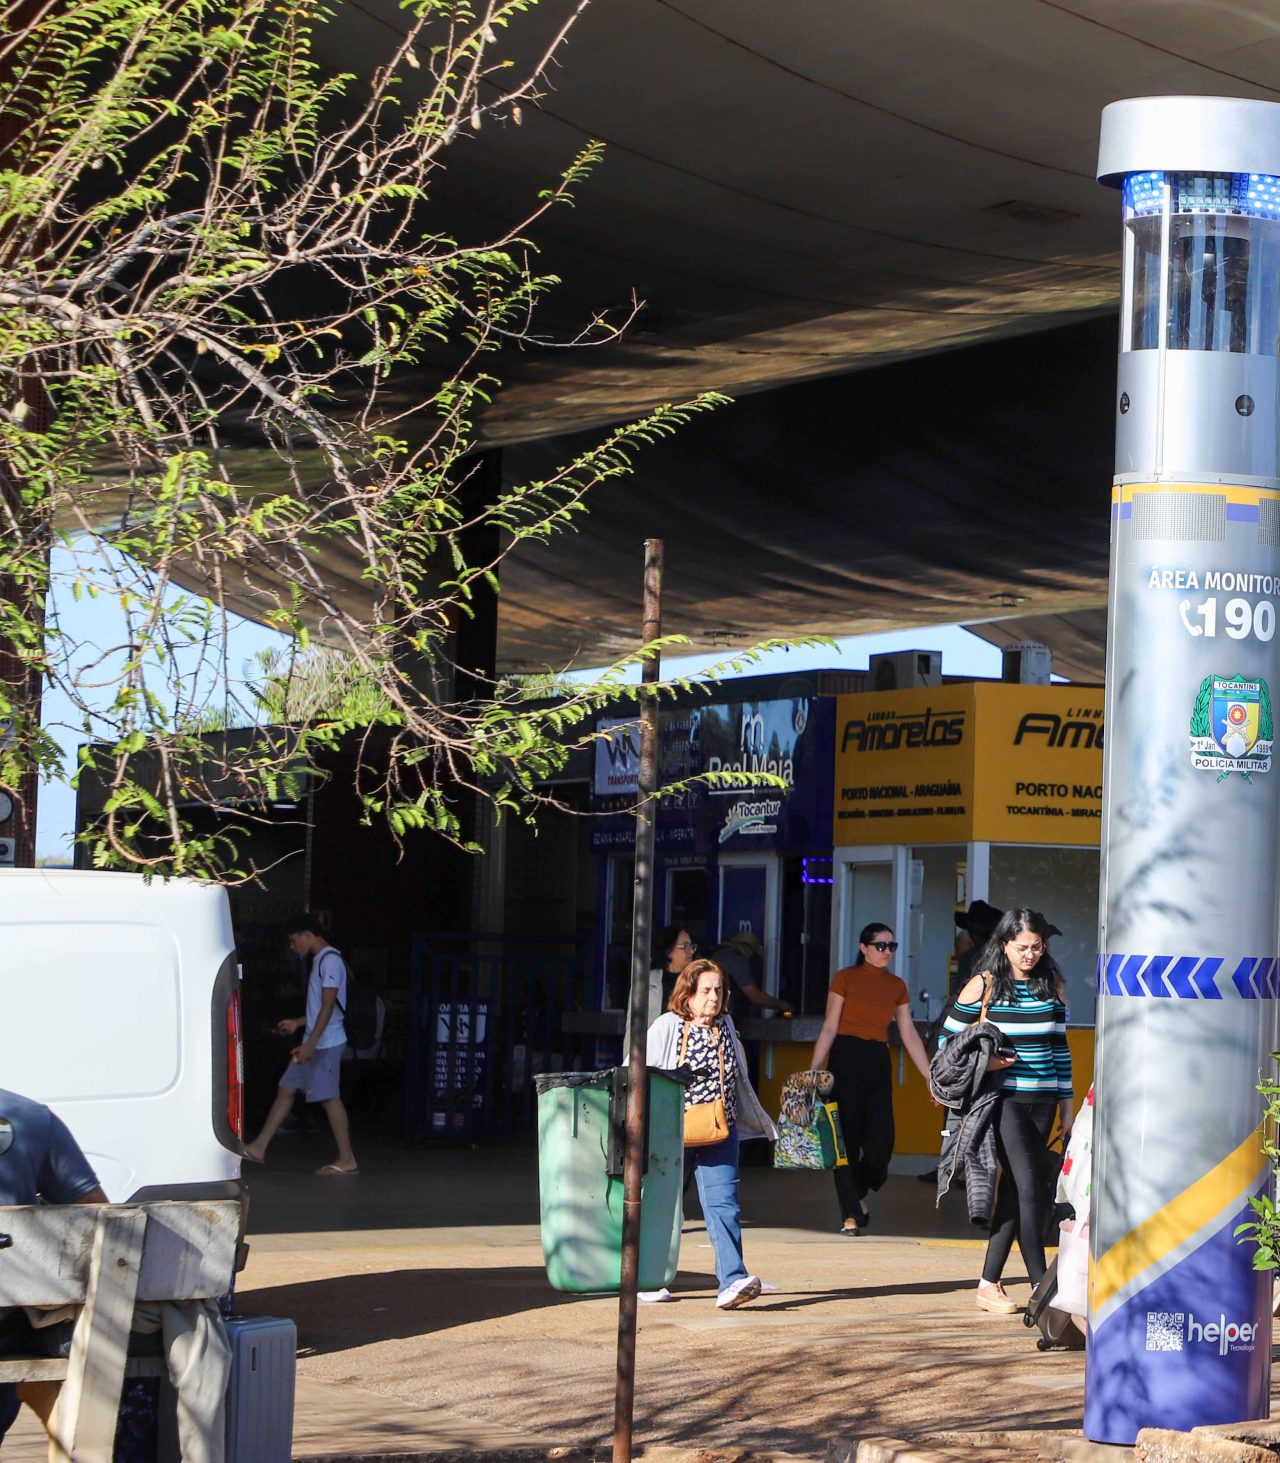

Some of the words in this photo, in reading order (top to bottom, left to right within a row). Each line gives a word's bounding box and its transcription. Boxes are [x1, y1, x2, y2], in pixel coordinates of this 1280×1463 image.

[1148, 566, 1199, 590] ÁREA
[1197, 598, 1276, 642] 190
[1217, 682, 1257, 691] TOCANTINS
[1195, 758, 1234, 768] POLÍCIA
[1236, 760, 1268, 770] MILITAR
[842, 787, 868, 800] PORTO
[1016, 782, 1068, 798] PORTO
[738, 798, 781, 816] Tocantur
[1006, 804, 1064, 816] TOCANTÍNIA
[1188, 1314, 1259, 1356] helper
